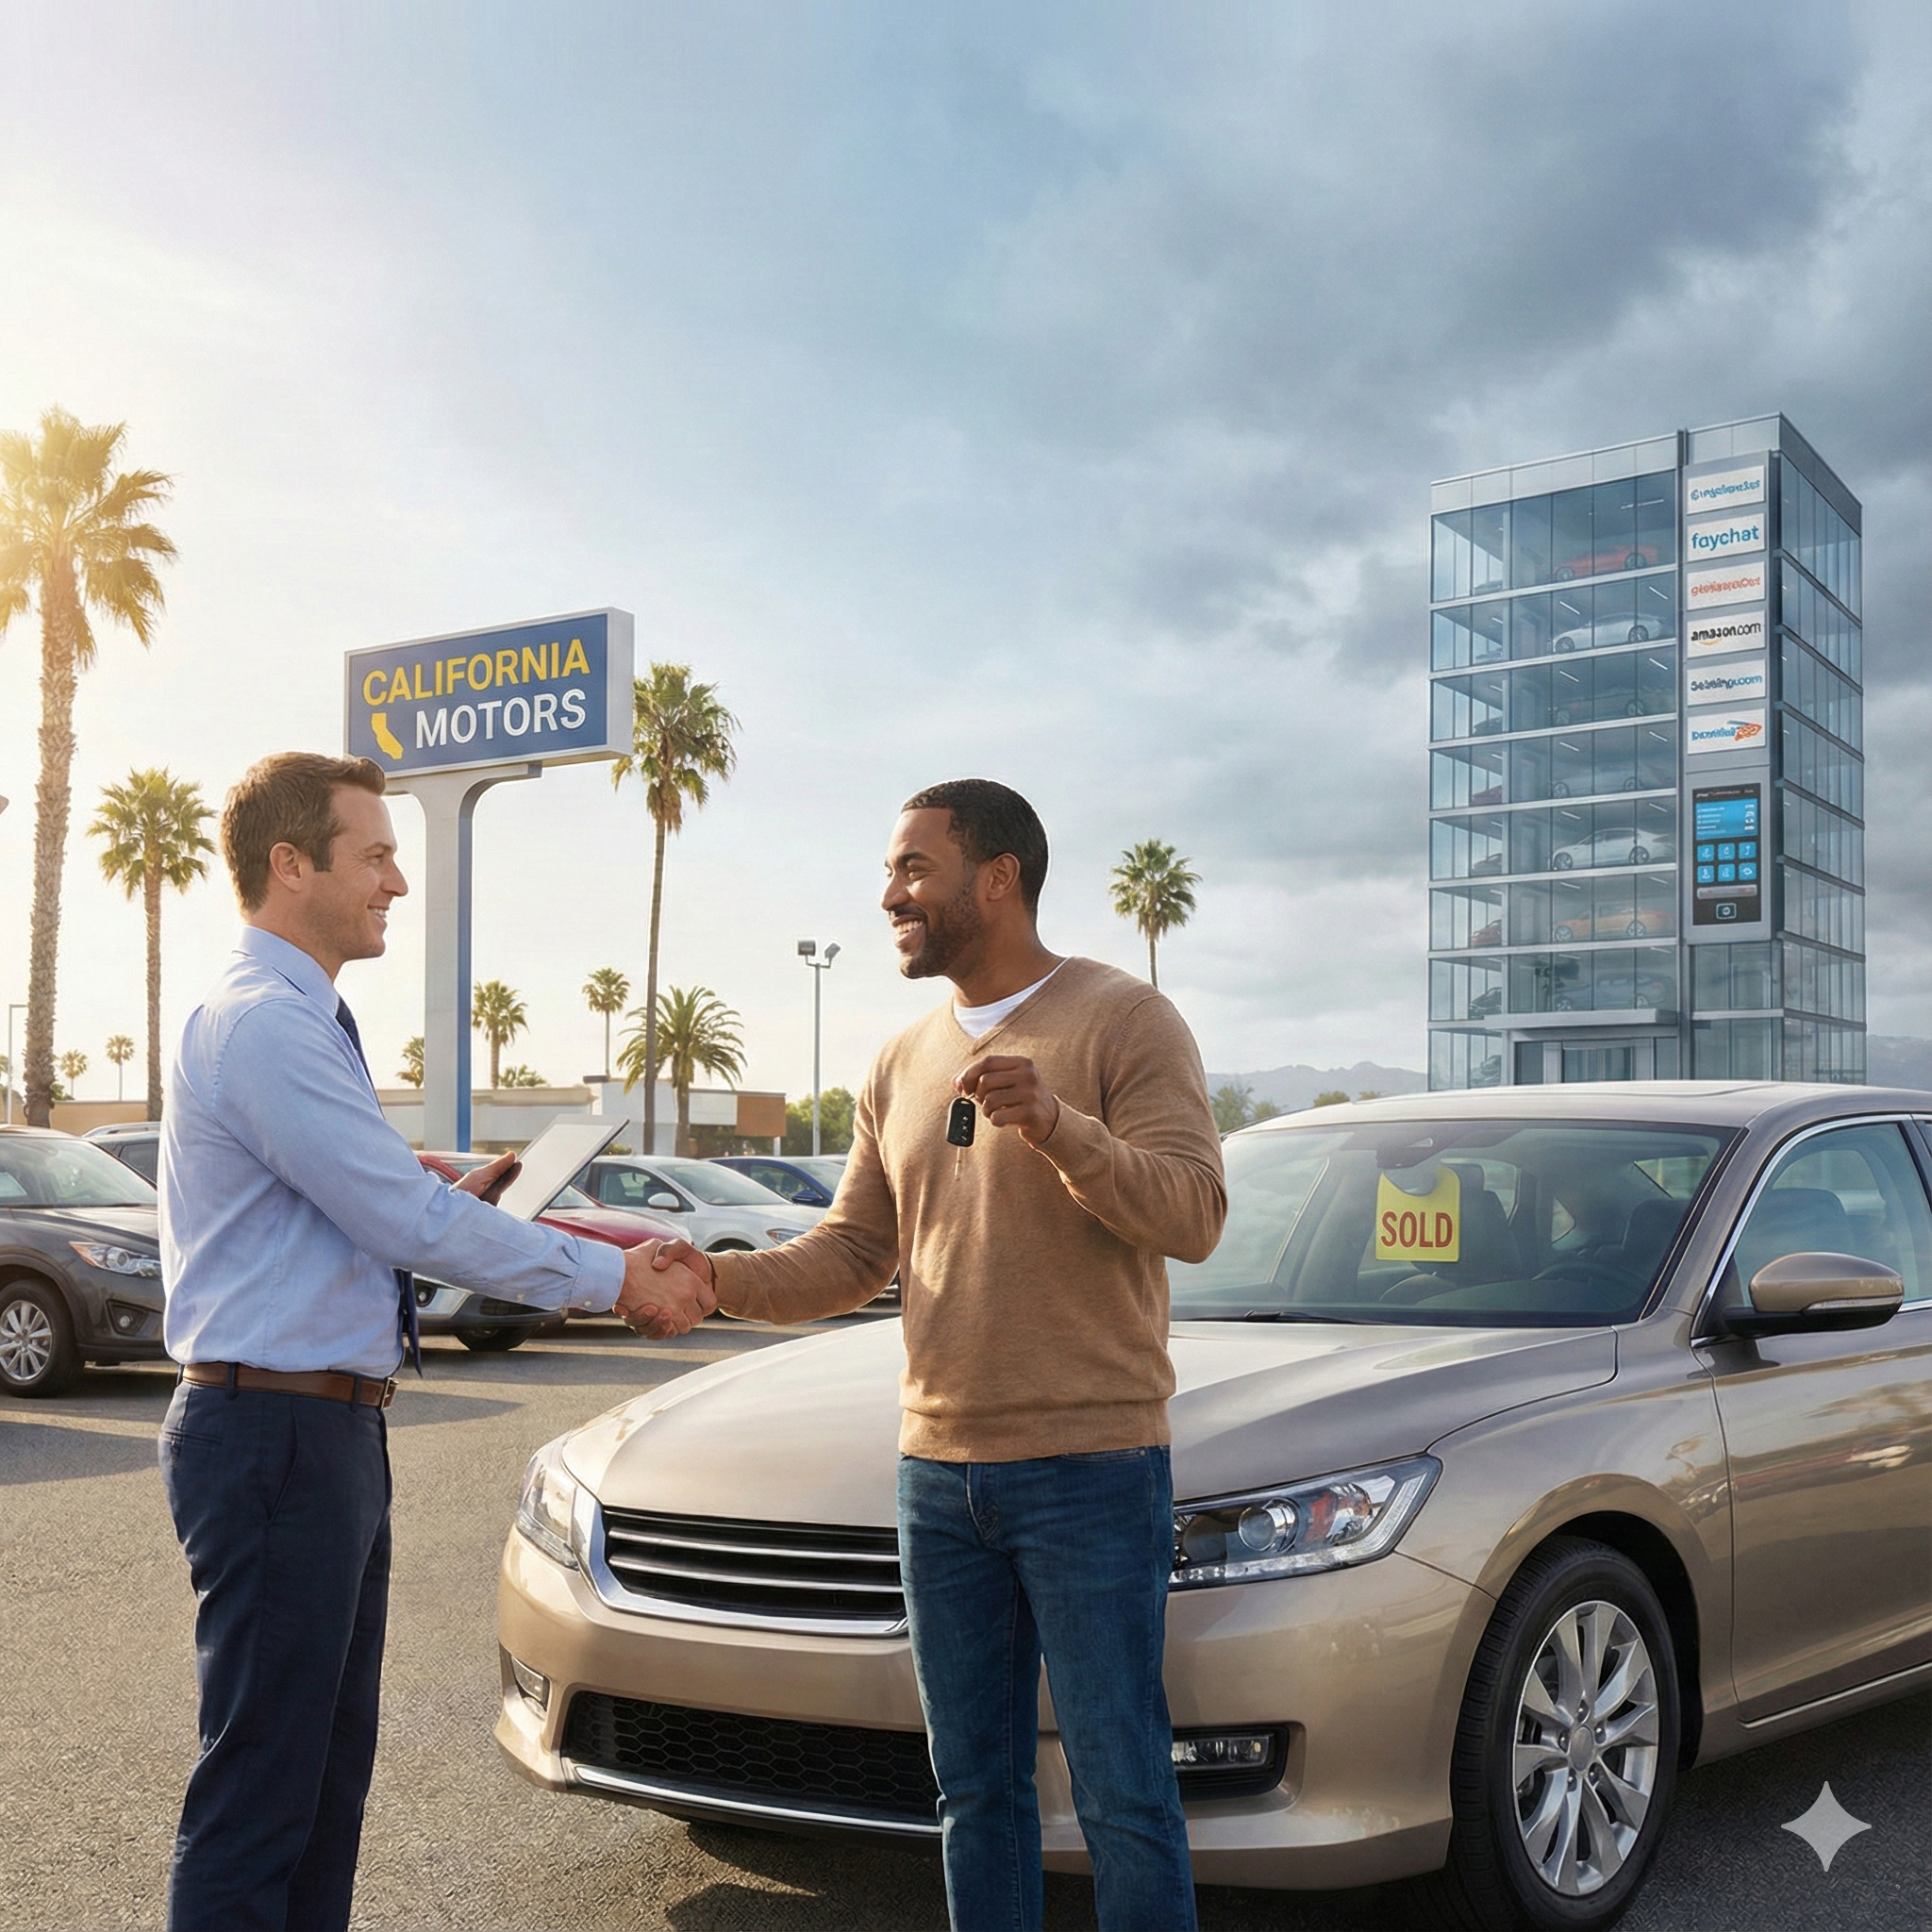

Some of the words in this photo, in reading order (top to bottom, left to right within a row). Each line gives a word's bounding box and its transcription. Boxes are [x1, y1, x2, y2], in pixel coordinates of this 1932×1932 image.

[1691, 525, 1759, 552] faychat
[362, 639, 591, 706] CALIFORNIA
[416, 689, 586, 749] MOTORS
[1380, 1210, 1453, 1248] SOLD
